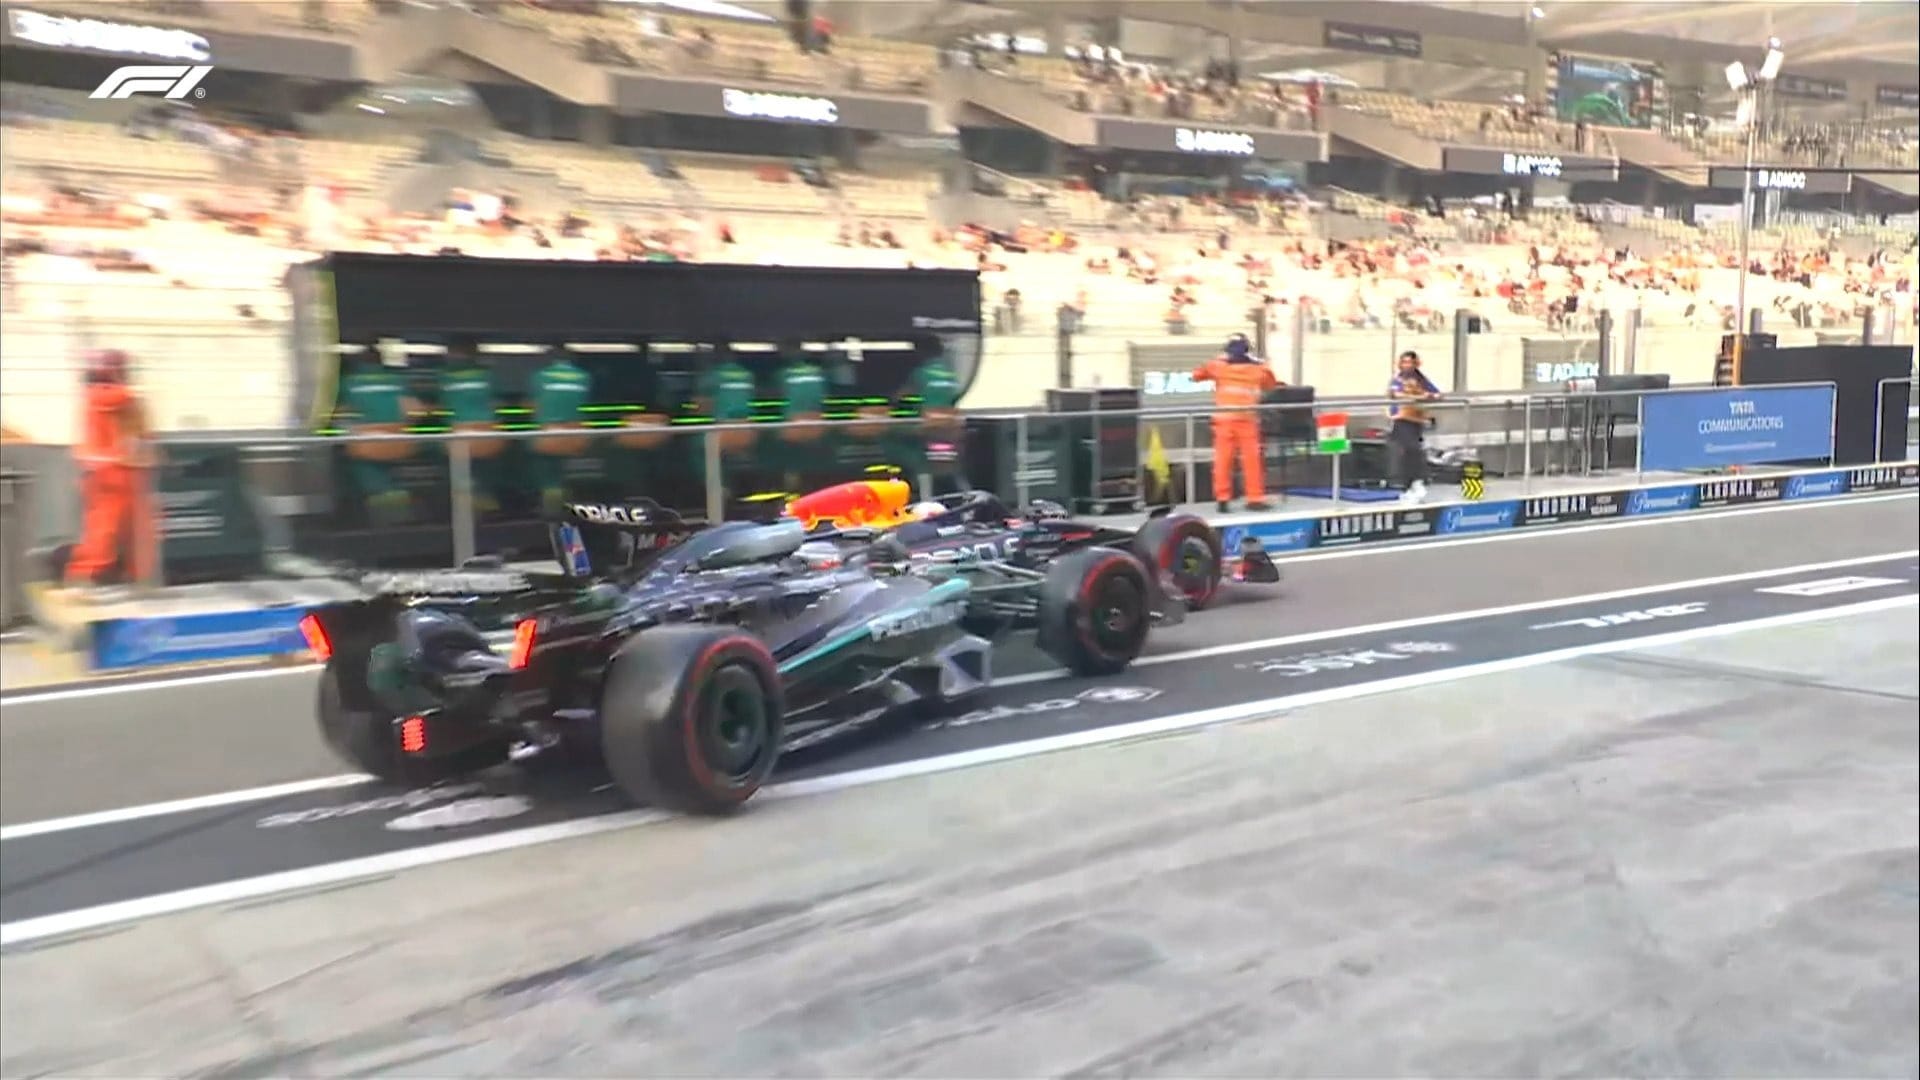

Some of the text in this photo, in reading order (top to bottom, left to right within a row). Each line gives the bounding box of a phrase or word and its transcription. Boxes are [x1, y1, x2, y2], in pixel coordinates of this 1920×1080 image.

[1769, 170, 1806, 189] ADNOC
[1729, 400, 1755, 414] TATA
[1698, 416, 1783, 434] COMMUNICATIONS
